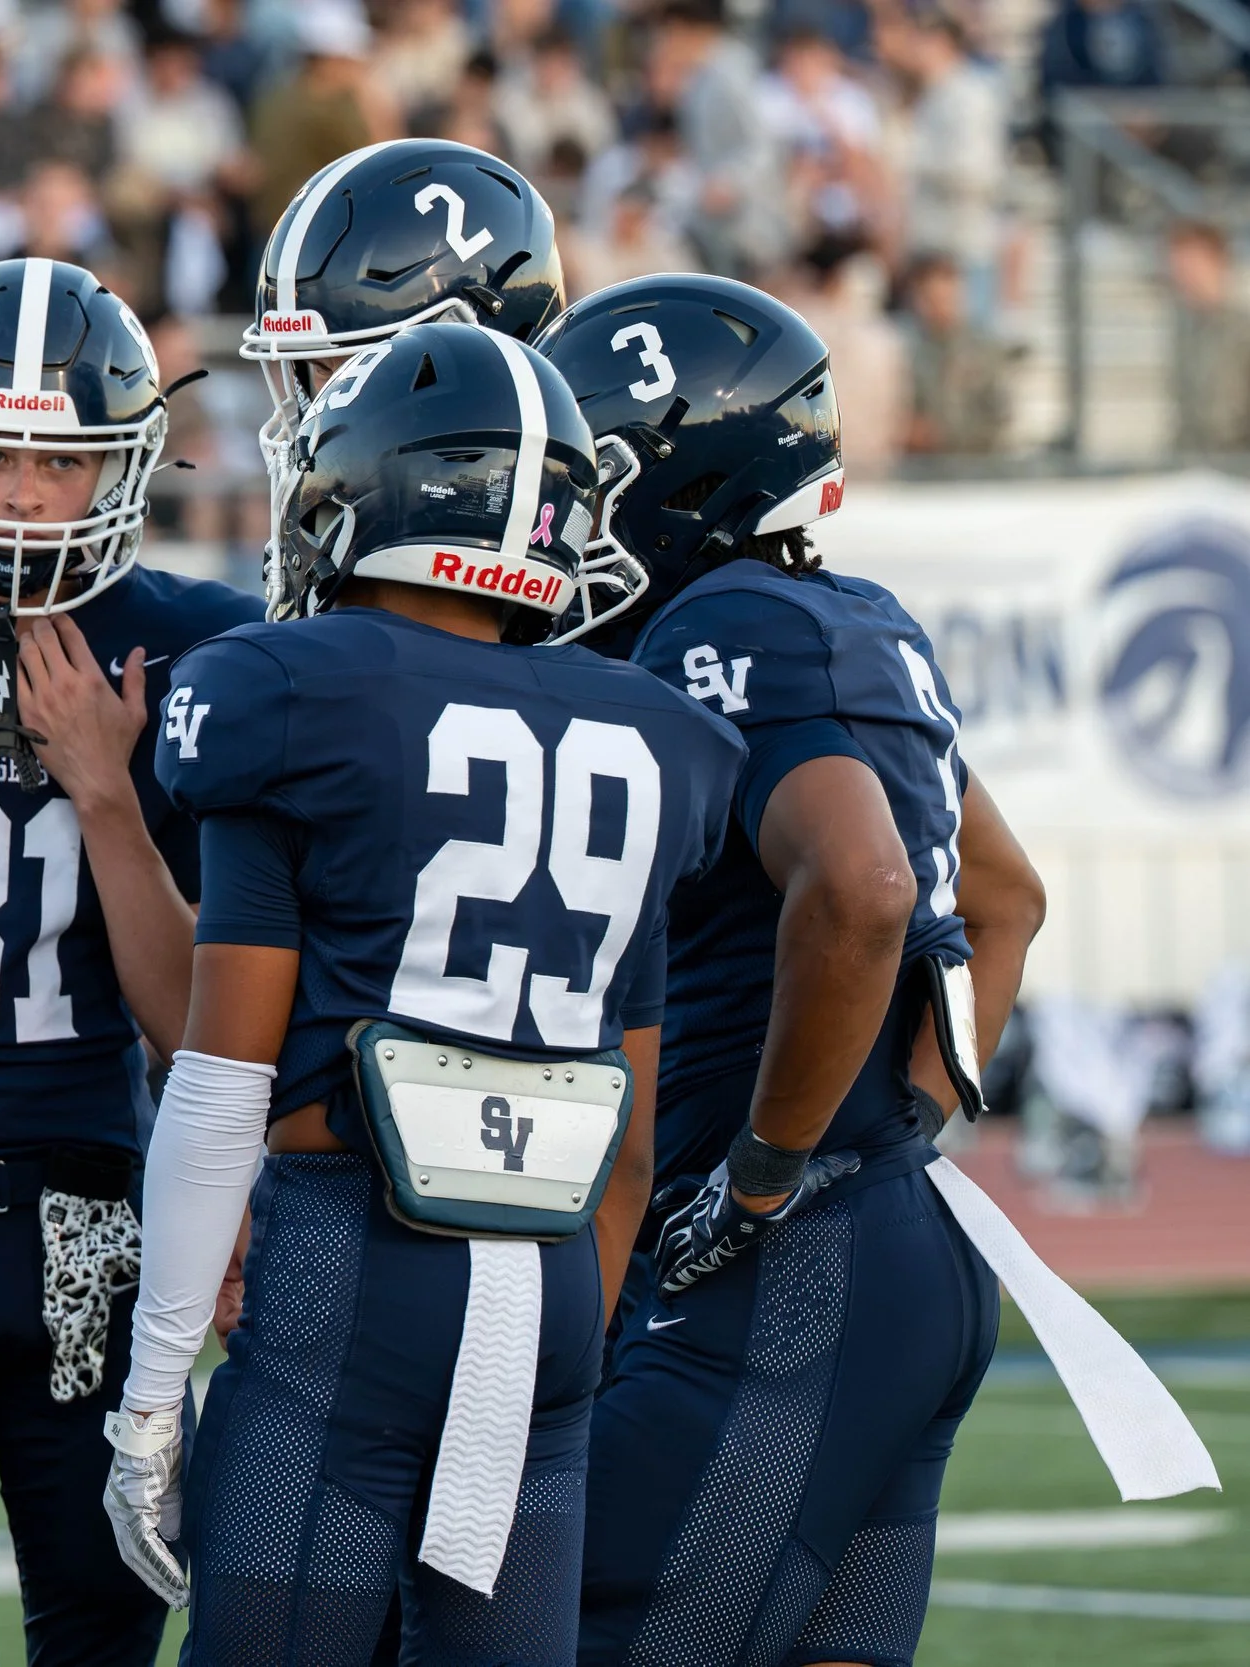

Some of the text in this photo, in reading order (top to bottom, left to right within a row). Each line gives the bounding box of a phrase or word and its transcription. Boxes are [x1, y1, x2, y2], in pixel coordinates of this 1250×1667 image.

[414, 183, 494, 263] 2
[263, 316, 312, 333] Riddell
[610, 322, 676, 403] 3
[777, 431, 805, 446] Riddell
[96, 465, 143, 514] Riddll
[420, 483, 456, 496] Riddell
[431, 552, 563, 605] Riddell
[682, 644, 752, 714] SV
[166, 687, 210, 759] SV
[388, 702, 661, 1048] 29
[481, 1095, 533, 1172] SV
